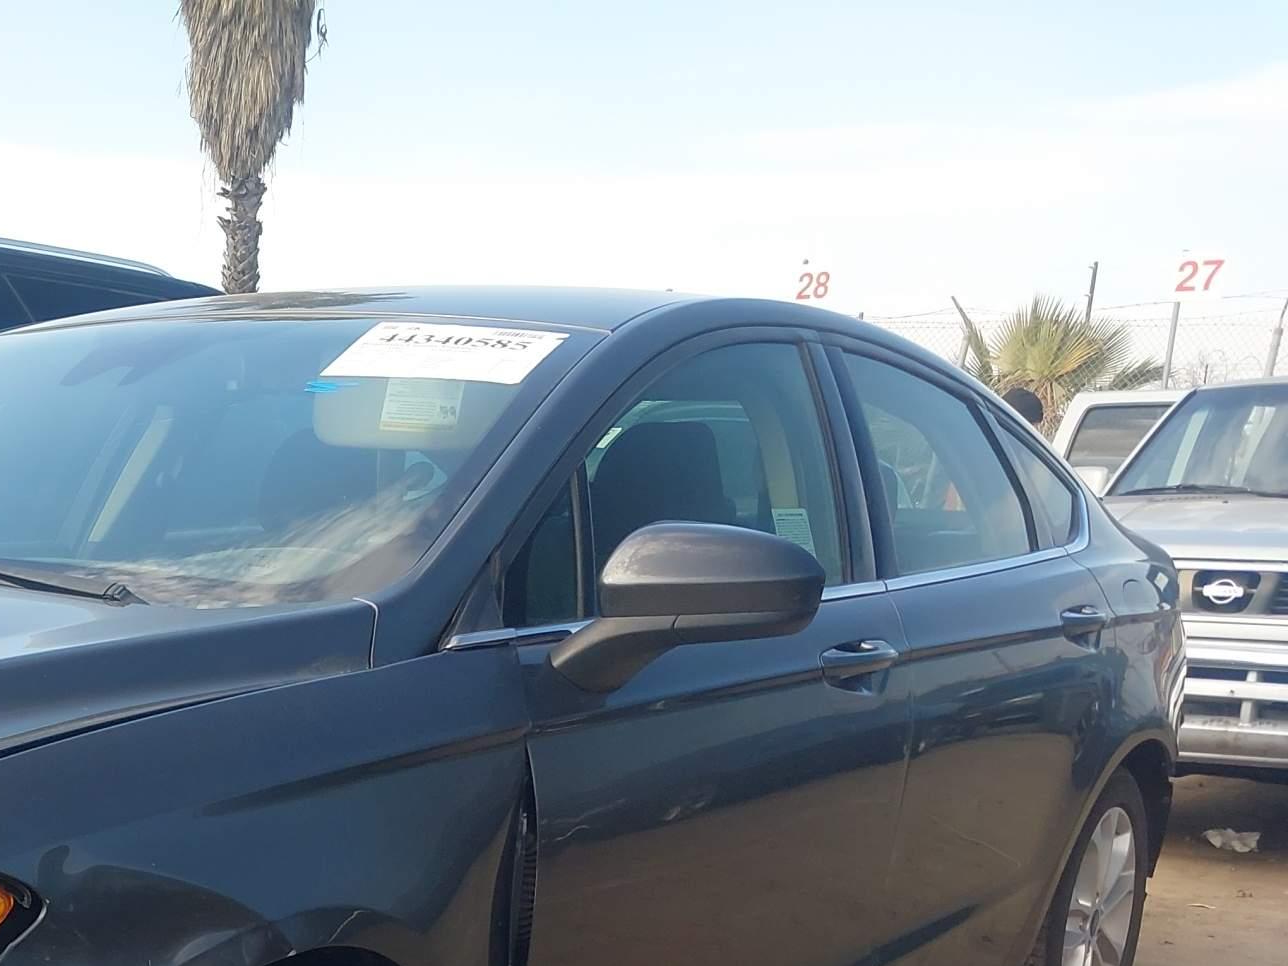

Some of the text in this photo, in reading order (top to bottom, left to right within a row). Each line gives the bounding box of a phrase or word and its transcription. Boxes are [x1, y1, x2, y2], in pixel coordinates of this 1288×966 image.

[795, 272, 830, 300] 28
[1175, 260, 1225, 292] 27
[380, 333, 534, 350] 44340585
